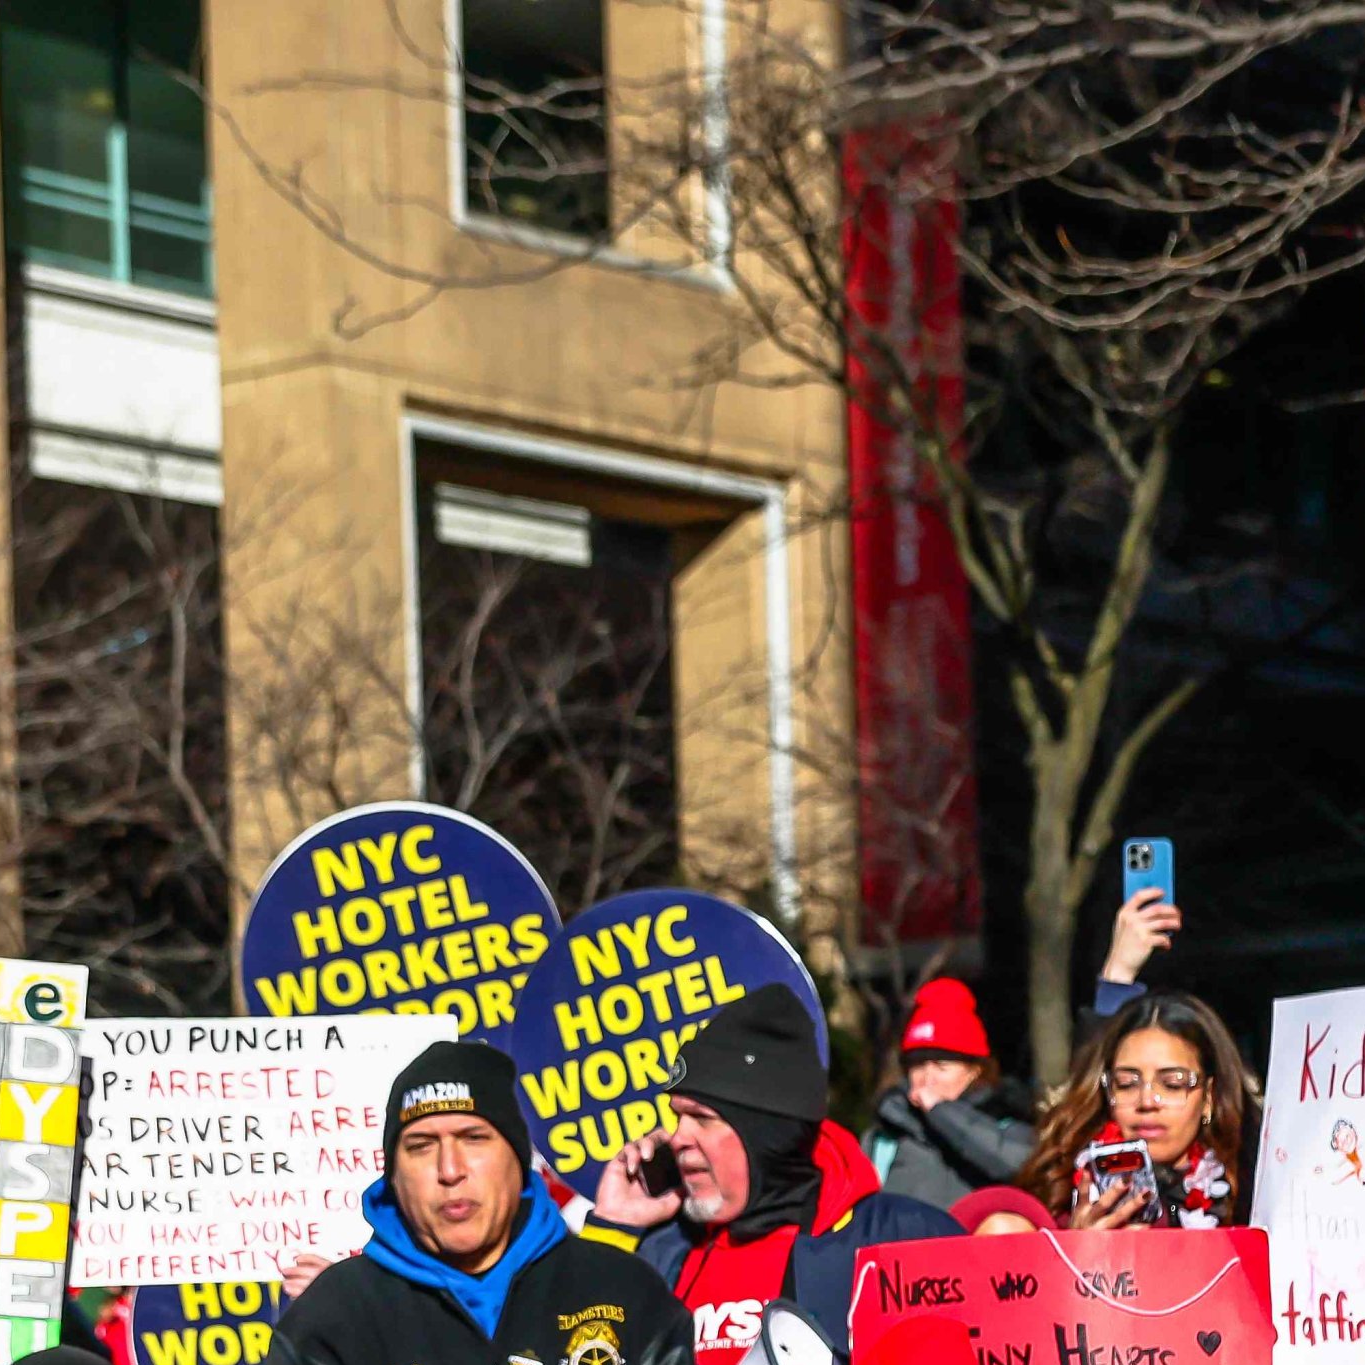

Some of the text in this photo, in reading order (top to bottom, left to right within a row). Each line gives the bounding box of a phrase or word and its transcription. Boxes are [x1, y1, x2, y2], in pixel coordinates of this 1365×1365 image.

[310, 824, 443, 899] NYC
[292, 872, 490, 960] HOTEL
[567, 904, 697, 987] NYC
[254, 912, 551, 1018] WORKERS
[554, 954, 746, 1052] HOTEL
[102, 1025, 345, 1057] YOU PUNCH A
[147, 1067, 337, 1100] ARRESTED
[401, 1082, 471, 1112] AMAZON
[130, 1115, 264, 1143] DRIVER
[289, 1106, 378, 1138] ARRE
[142, 1151, 295, 1179] TENDER
[88, 1187, 203, 1214] NURSE
[229, 1189, 308, 1208] WHAT
[150, 1223, 220, 1247] HAVE
[240, 1219, 321, 1247] DONE
[878, 1260, 966, 1314] NURSES
